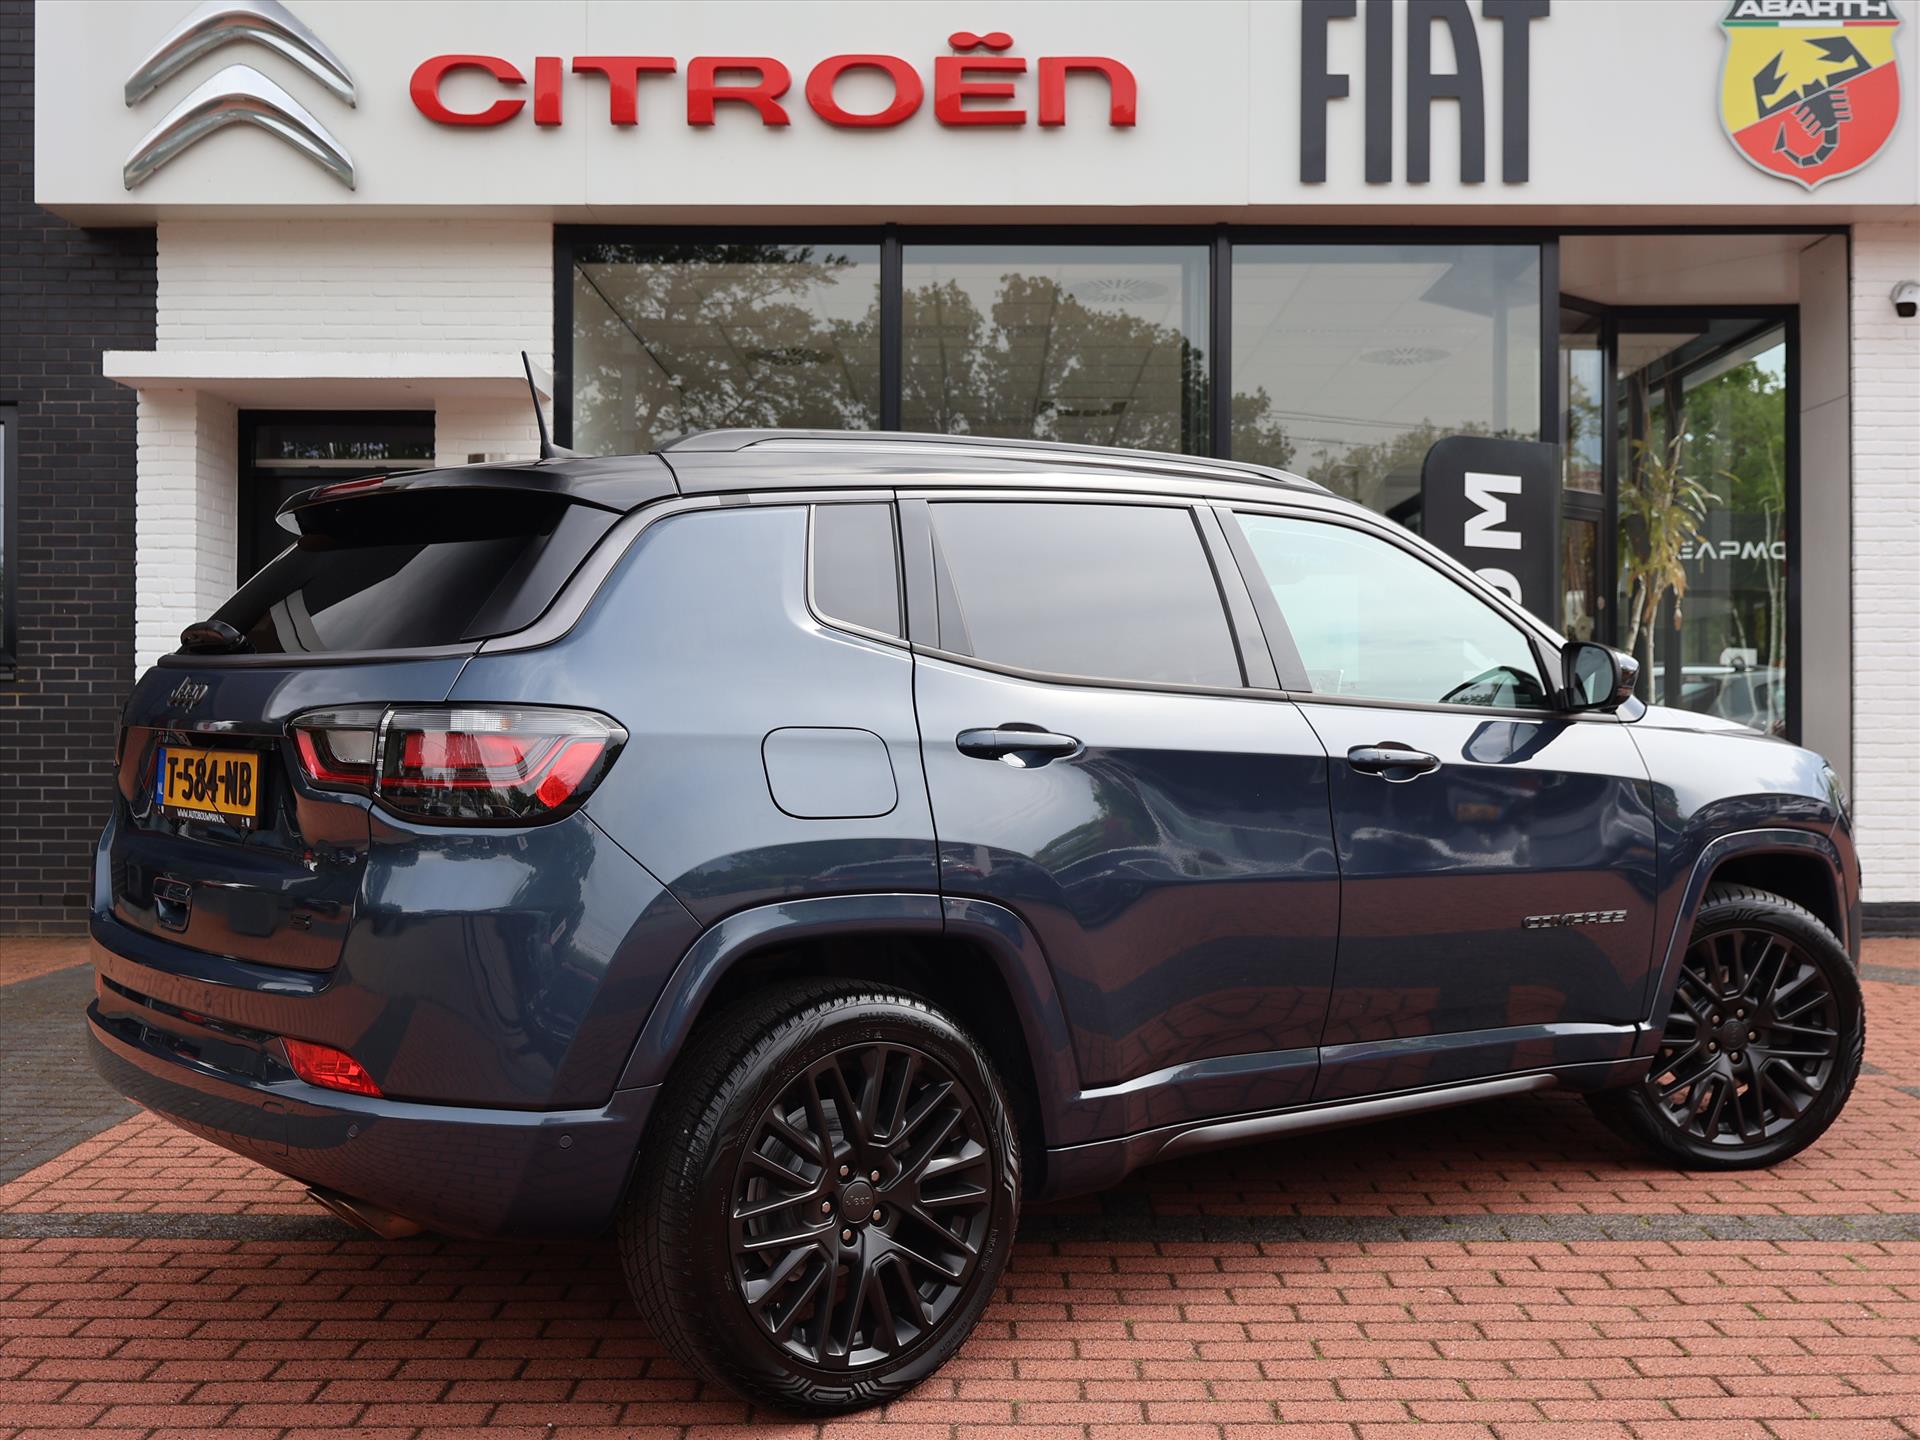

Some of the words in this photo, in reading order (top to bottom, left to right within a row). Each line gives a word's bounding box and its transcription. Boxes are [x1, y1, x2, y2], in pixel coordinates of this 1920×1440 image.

[1734, 0, 1888, 17] ABARTH
[1300, 0, 1550, 183] FIAT
[168, 757, 251, 806] T-584-NB
